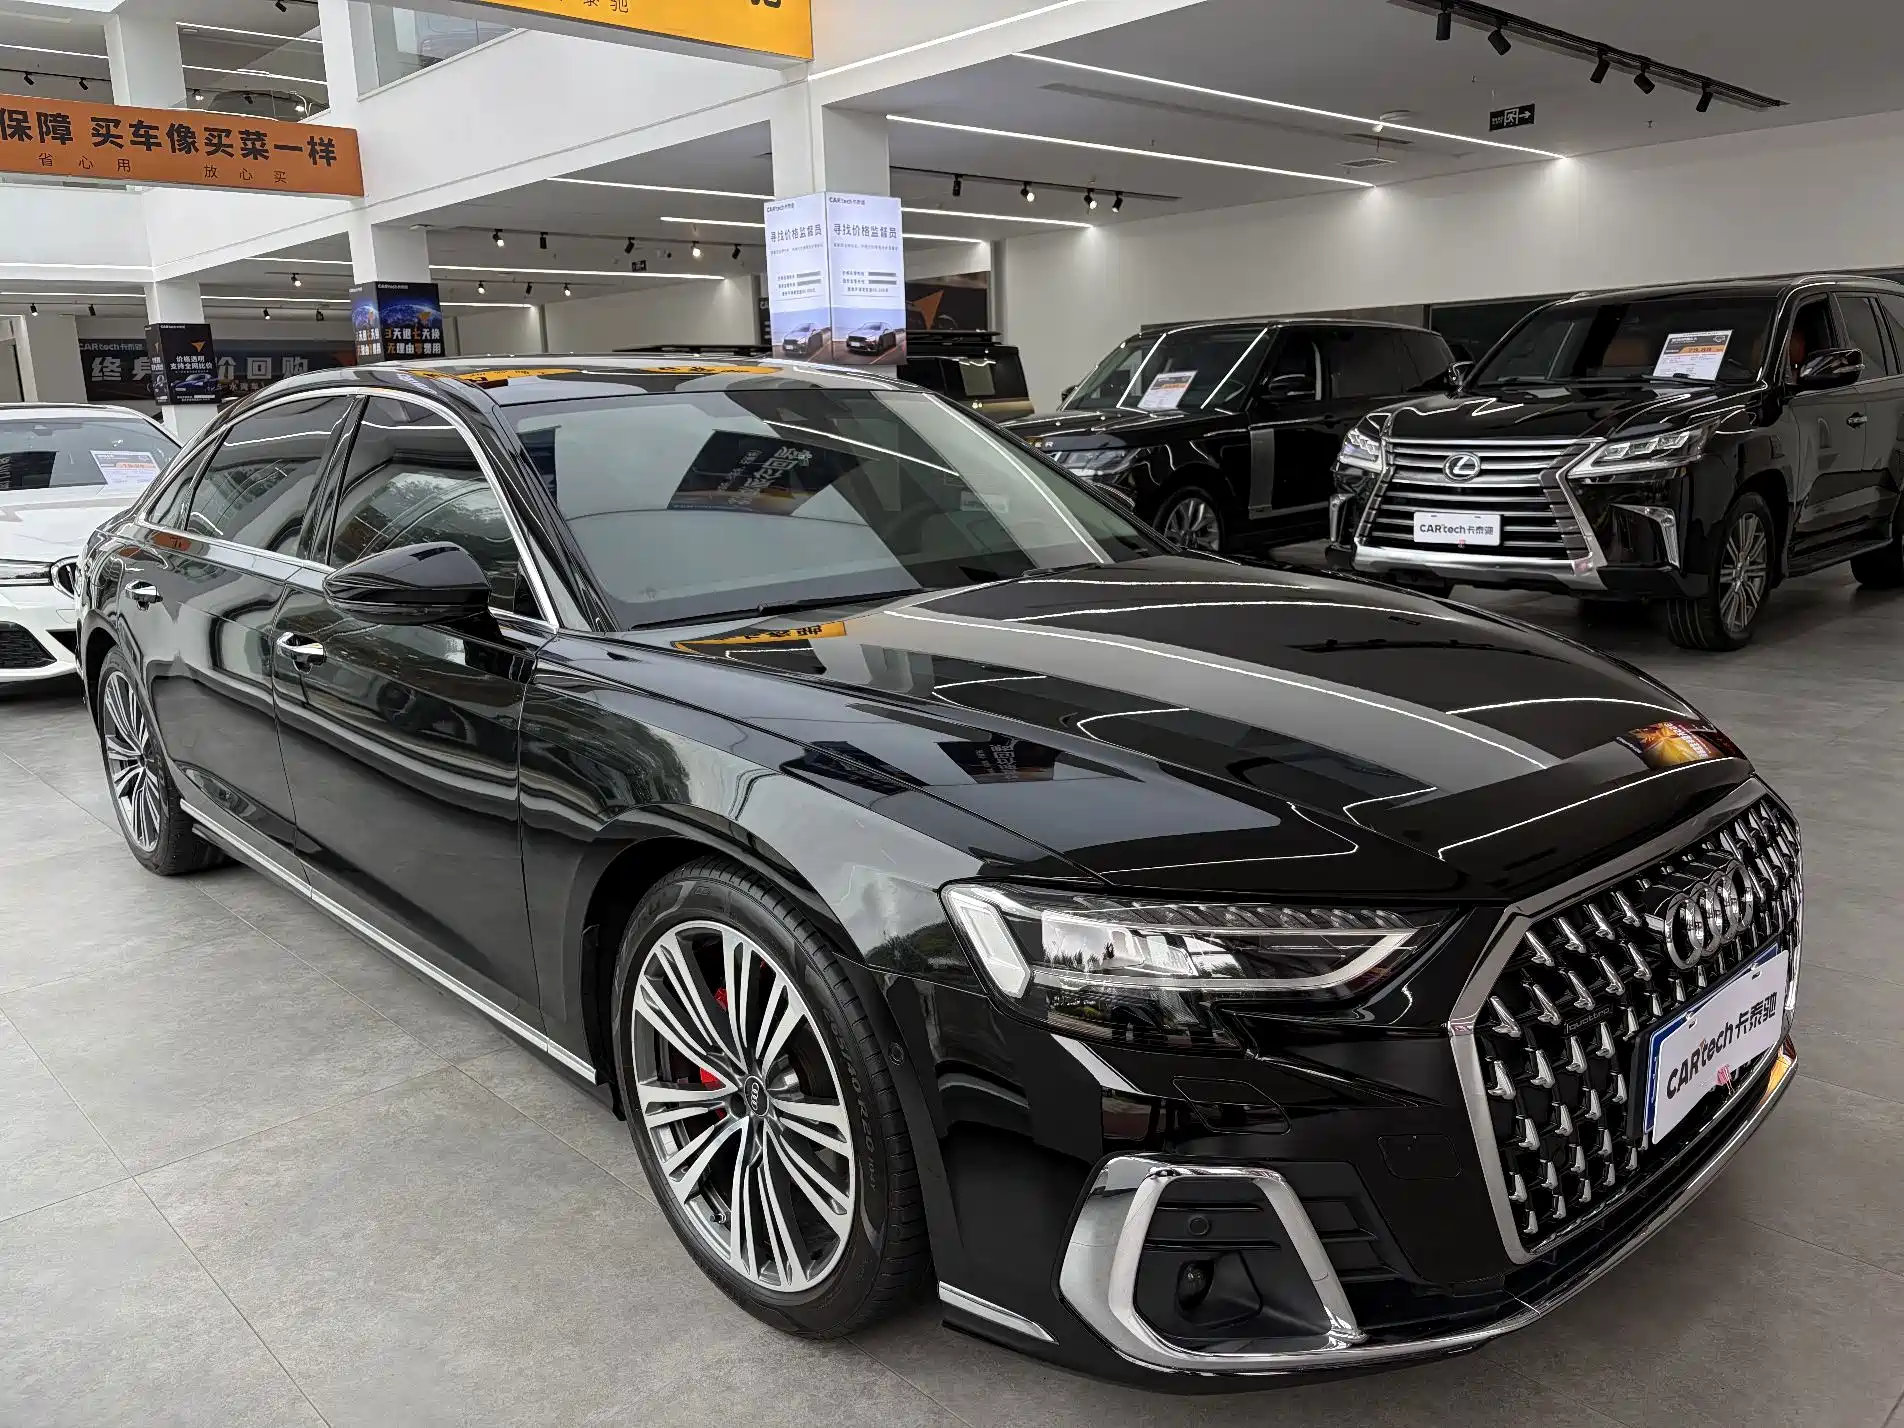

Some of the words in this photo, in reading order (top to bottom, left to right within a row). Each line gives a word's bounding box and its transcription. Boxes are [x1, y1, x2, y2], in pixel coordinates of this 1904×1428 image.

[0, 107, 74, 146] 保障
[90, 115, 338, 168] 买车像买菜一样
[38, 151, 132, 173] 省心用
[203, 164, 288, 185] 放心买
